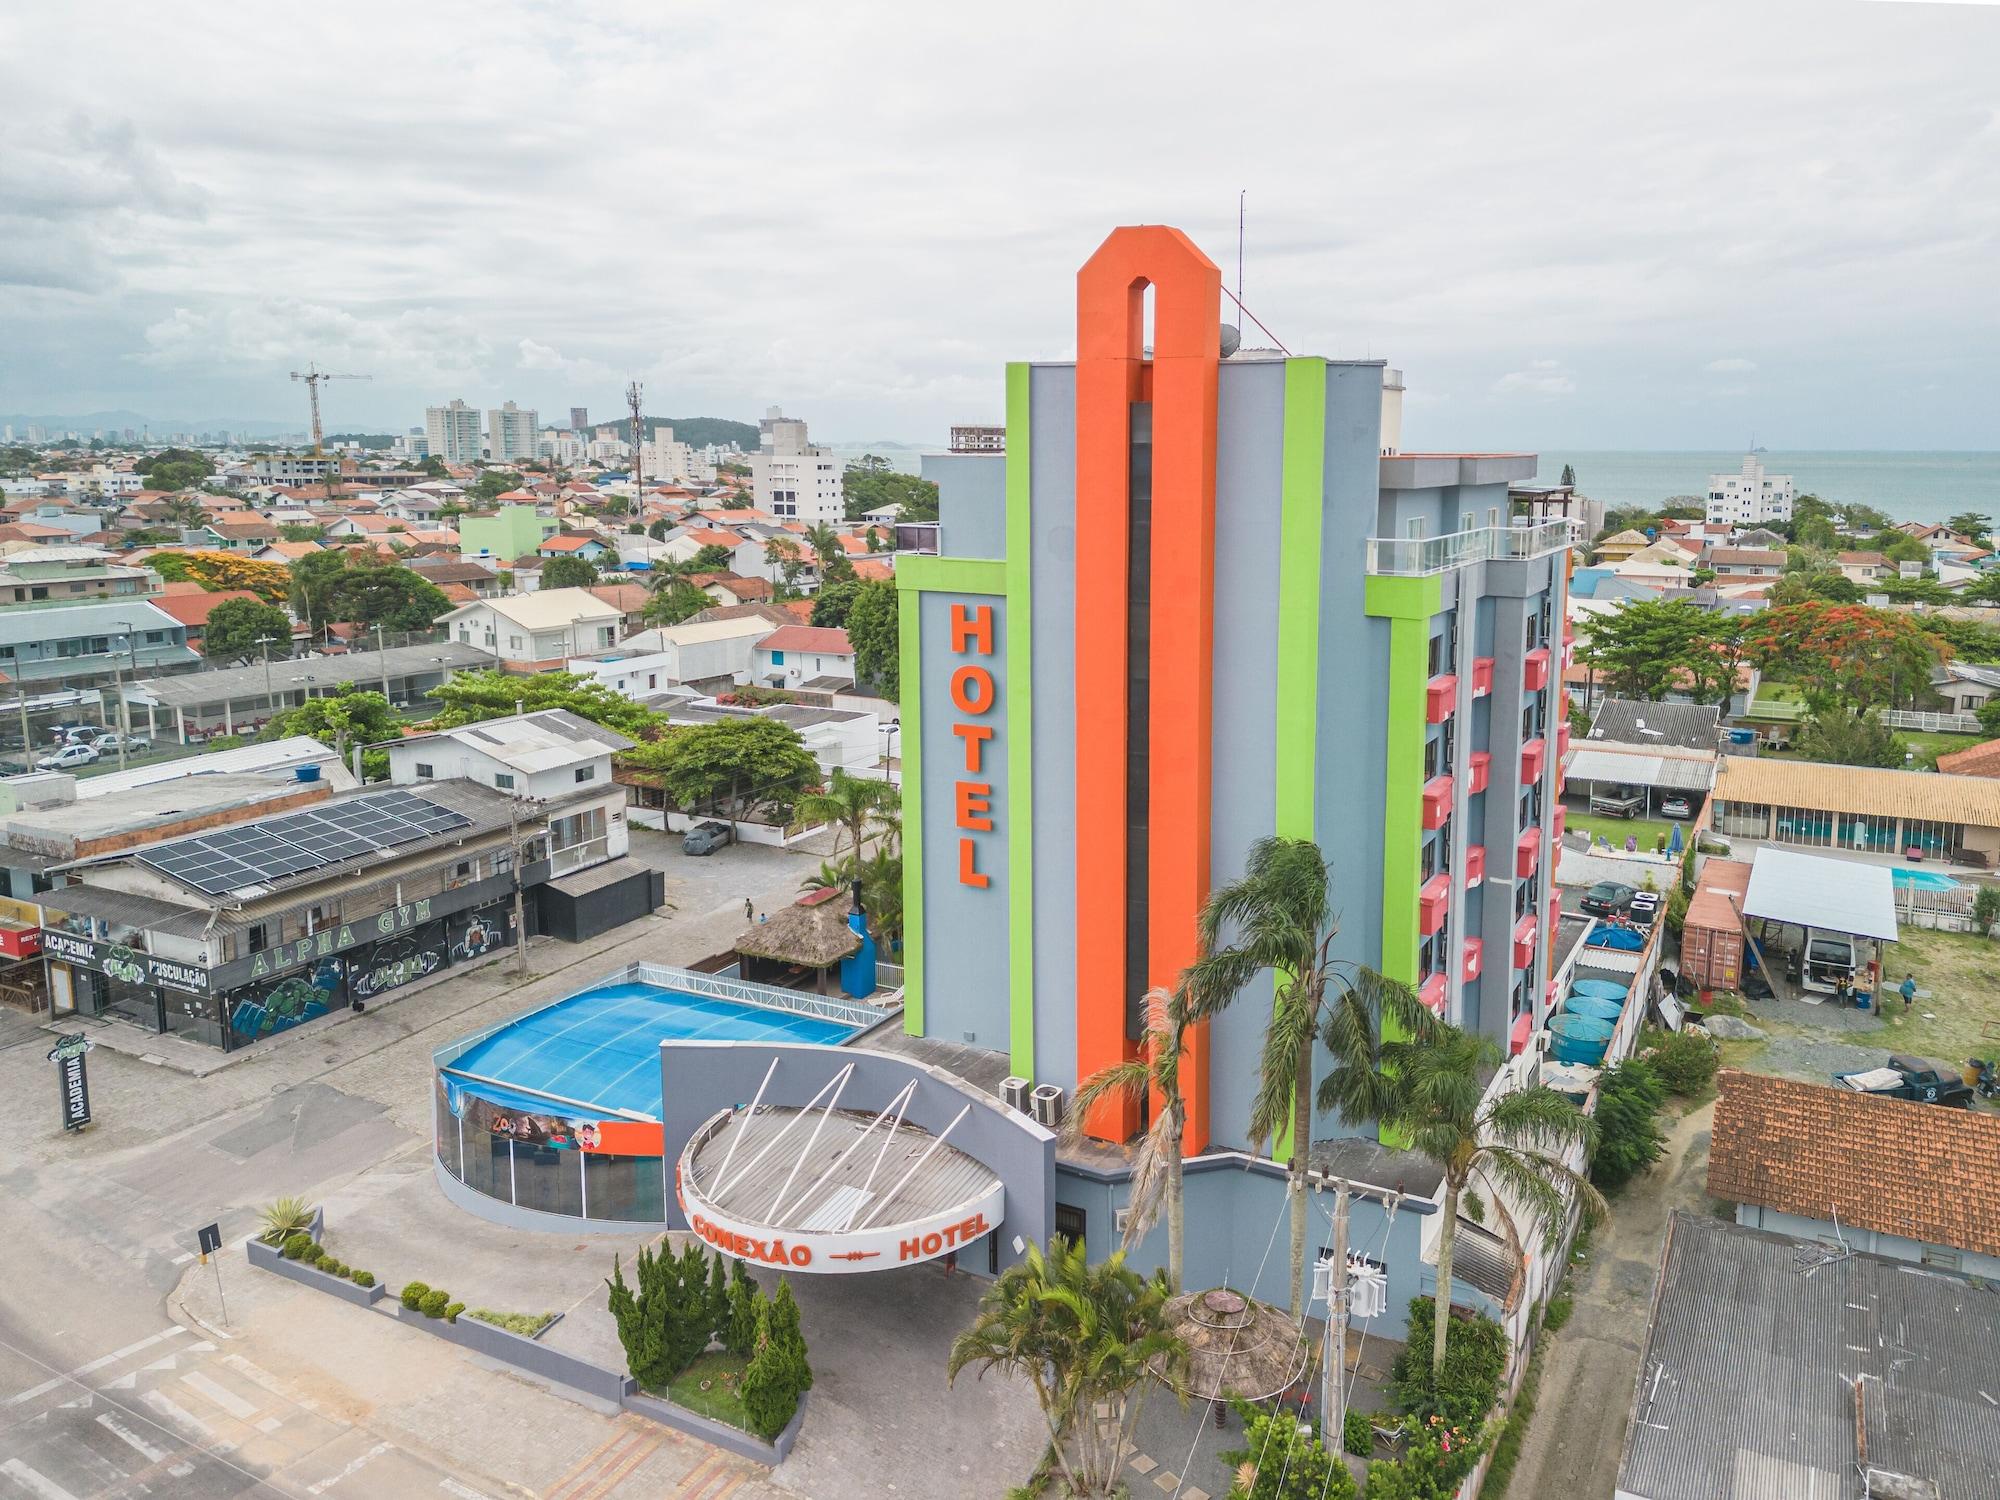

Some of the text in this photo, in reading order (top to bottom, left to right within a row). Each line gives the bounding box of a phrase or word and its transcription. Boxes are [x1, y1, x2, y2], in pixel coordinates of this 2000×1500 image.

[950, 604, 994, 888] HOTEL
[45, 935, 96, 960] ACADEMIA
[251, 898, 431, 978] ALPHA GYM
[148, 959, 207, 988] MUSCULAÇÃO
[67, 1056, 85, 1119] ACADEMIA
[692, 1212, 990, 1267] CONEXÃO HOTEL
